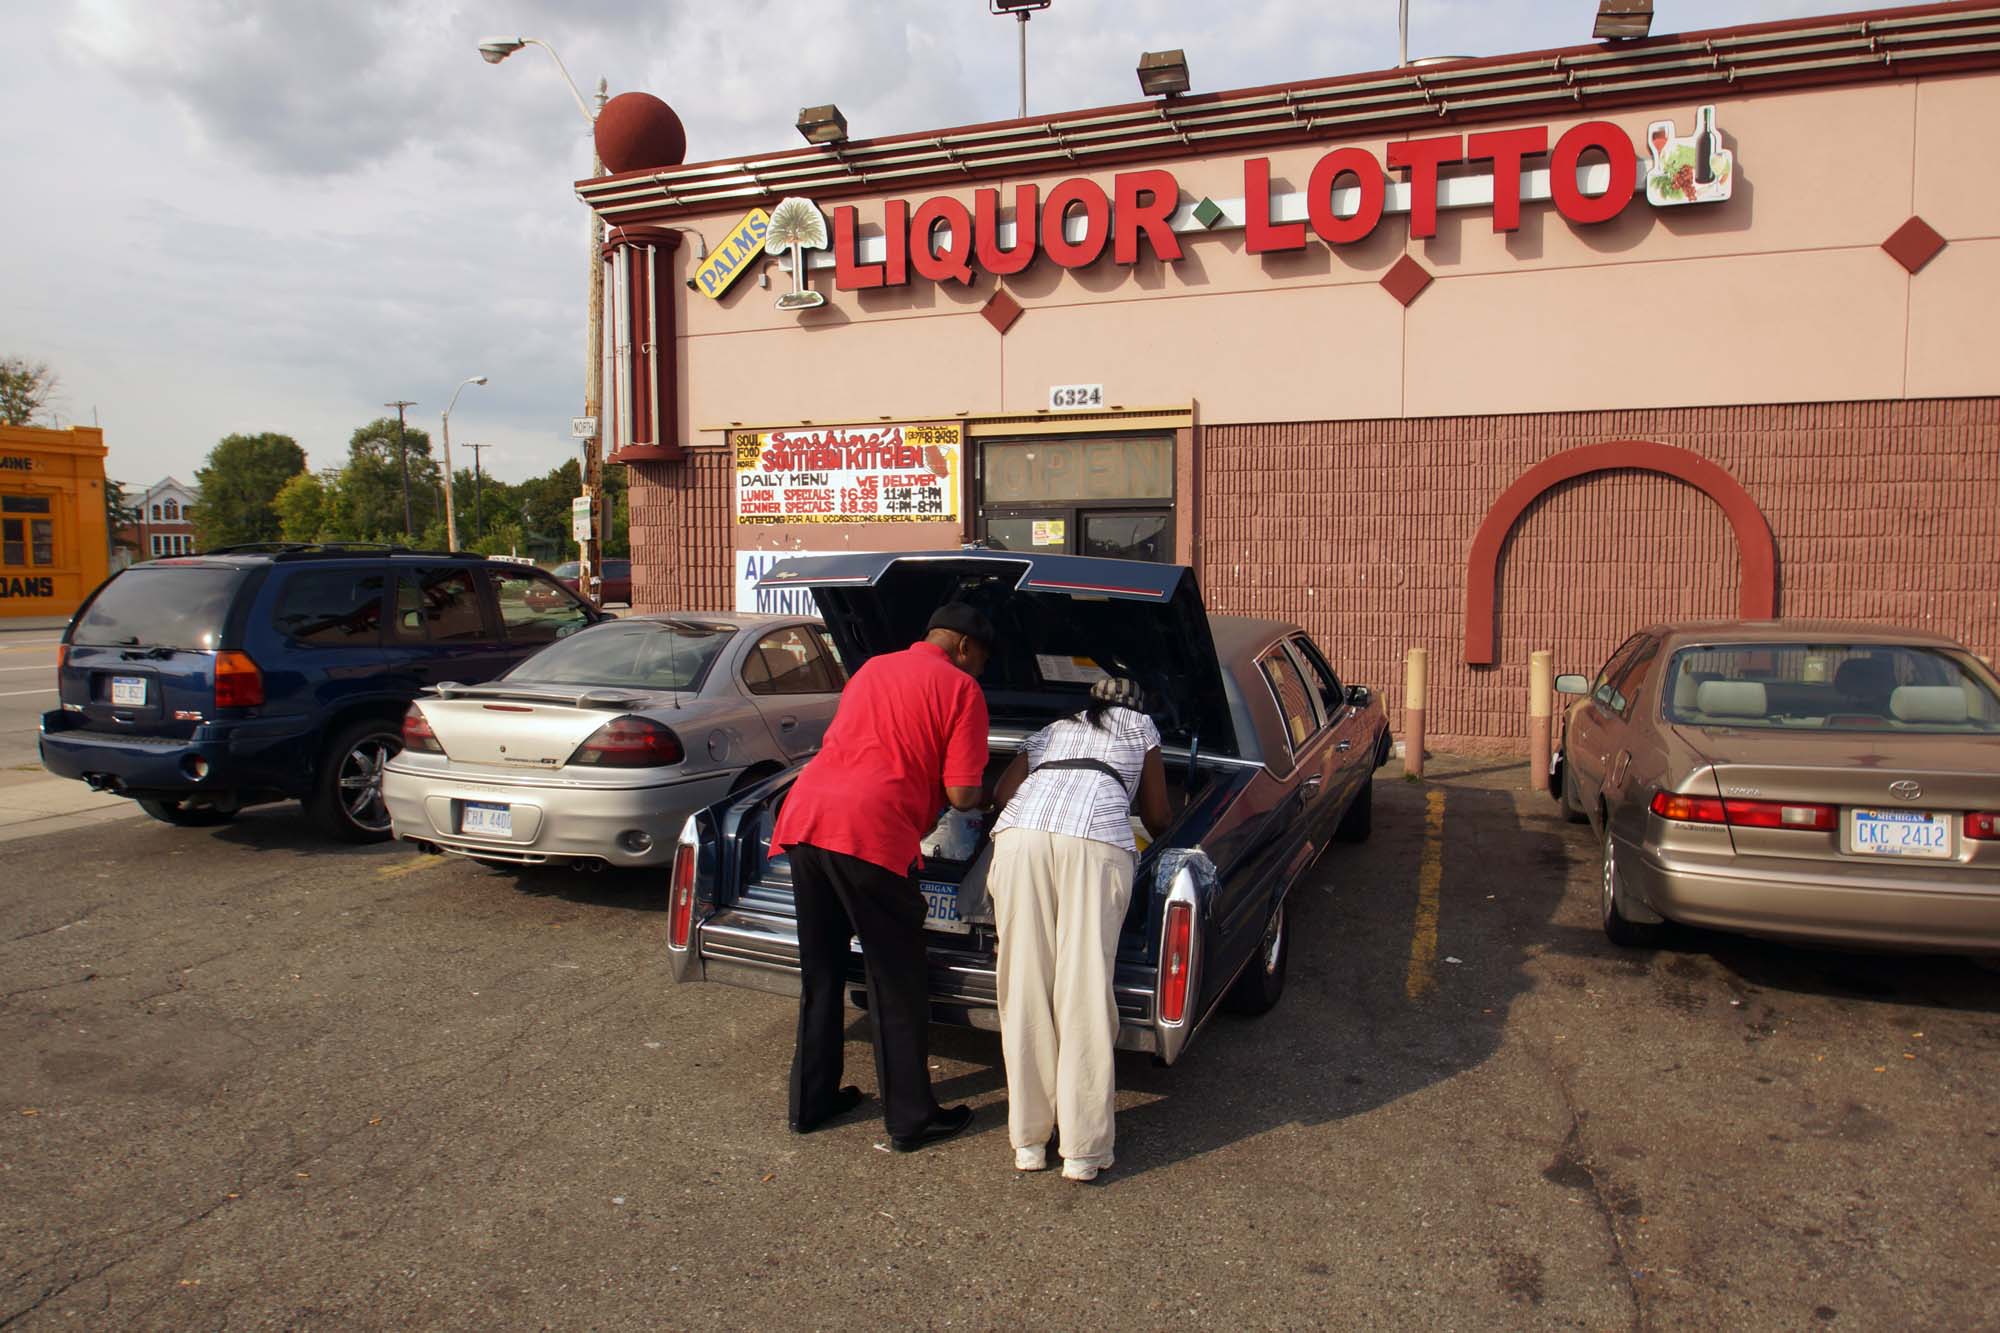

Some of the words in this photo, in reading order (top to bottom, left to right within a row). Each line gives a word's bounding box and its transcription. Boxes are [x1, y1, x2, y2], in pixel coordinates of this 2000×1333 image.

[834, 169, 1185, 291] LIQUOR
[1244, 120, 1638, 255] LOTTO
[700, 214, 768, 294] PALMS
[1053, 387, 1101, 407] 6324
[574, 421, 594, 434] NORTH
[736, 434, 761, 446] SOUL
[772, 427, 903, 450] Sunshine's
[736, 446, 760, 458] FOOD
[845, 445, 924, 470] KITCHEN
[991, 439, 1168, 498] OPEN
[741, 474, 784, 487] DAILY
[790, 472, 828, 486] MENU
[856, 476, 879, 488] WE
[882, 474, 937, 488] DELIVER
[741, 489, 774, 502] LUNCH
[783, 488, 835, 501] SPECIALS:
[840, 487, 878, 501] $6.99
[741, 502, 781, 514] DINNER
[785, 501, 835, 513] SPECIALS:
[840, 501, 878, 513] $8.99
[787, 515, 803, 523] FOR
[805, 514, 819, 523] ALL
[1876, 813, 1925, 823] MICHIGAN
[1859, 822, 1889, 844] CKC
[1901, 824, 1944, 848] 2412
